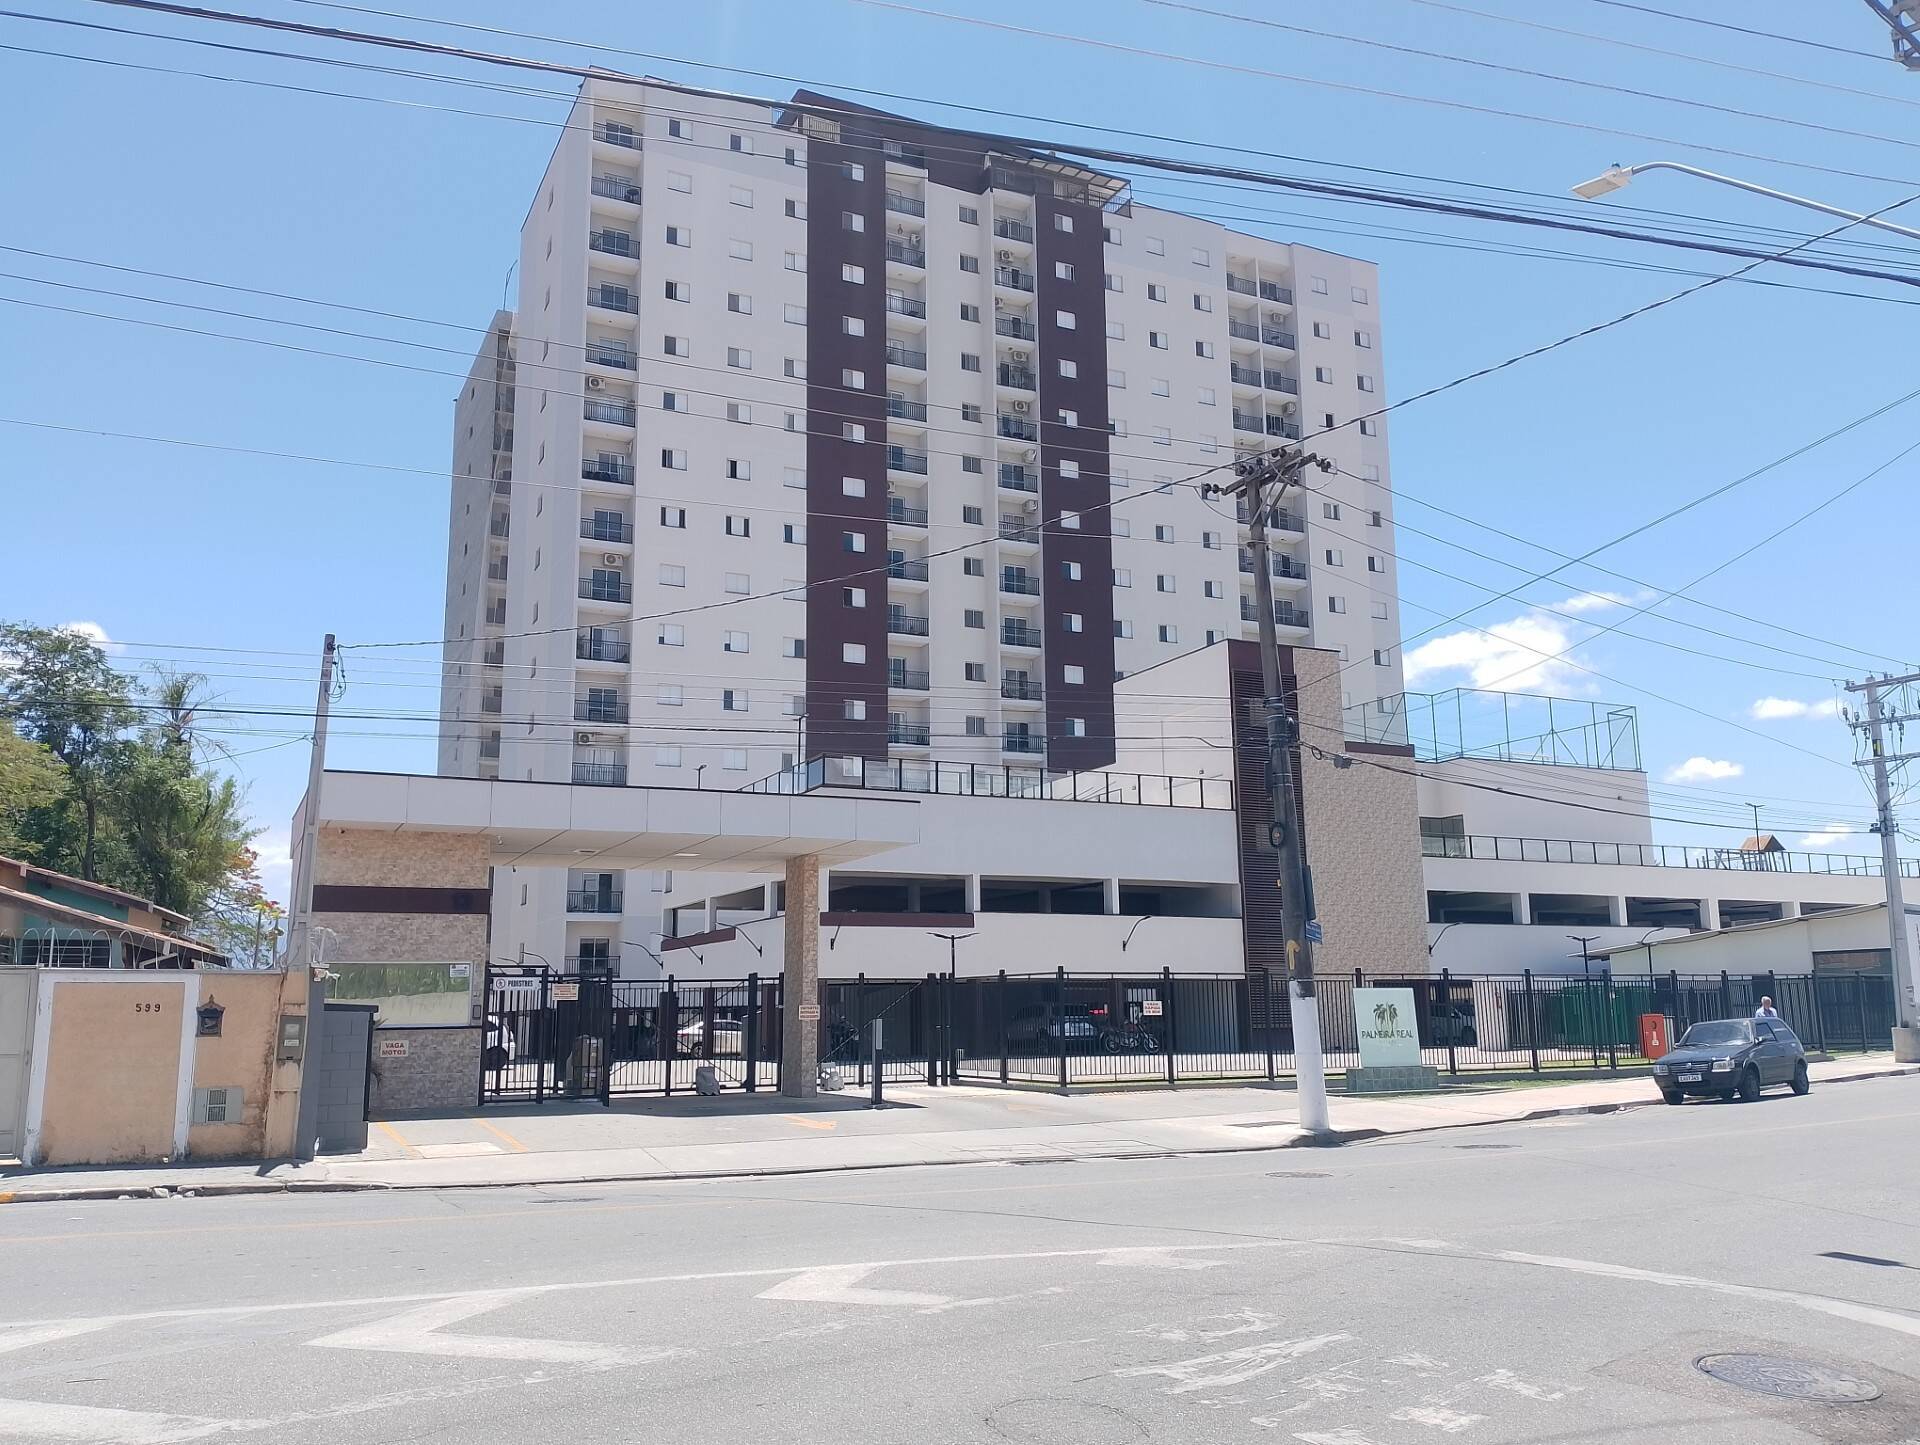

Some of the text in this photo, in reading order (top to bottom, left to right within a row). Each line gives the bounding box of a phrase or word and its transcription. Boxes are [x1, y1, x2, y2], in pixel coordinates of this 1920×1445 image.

[135, 1003, 161, 1013] 599
[1361, 1029, 1414, 1039] PALMEIRA REAL
